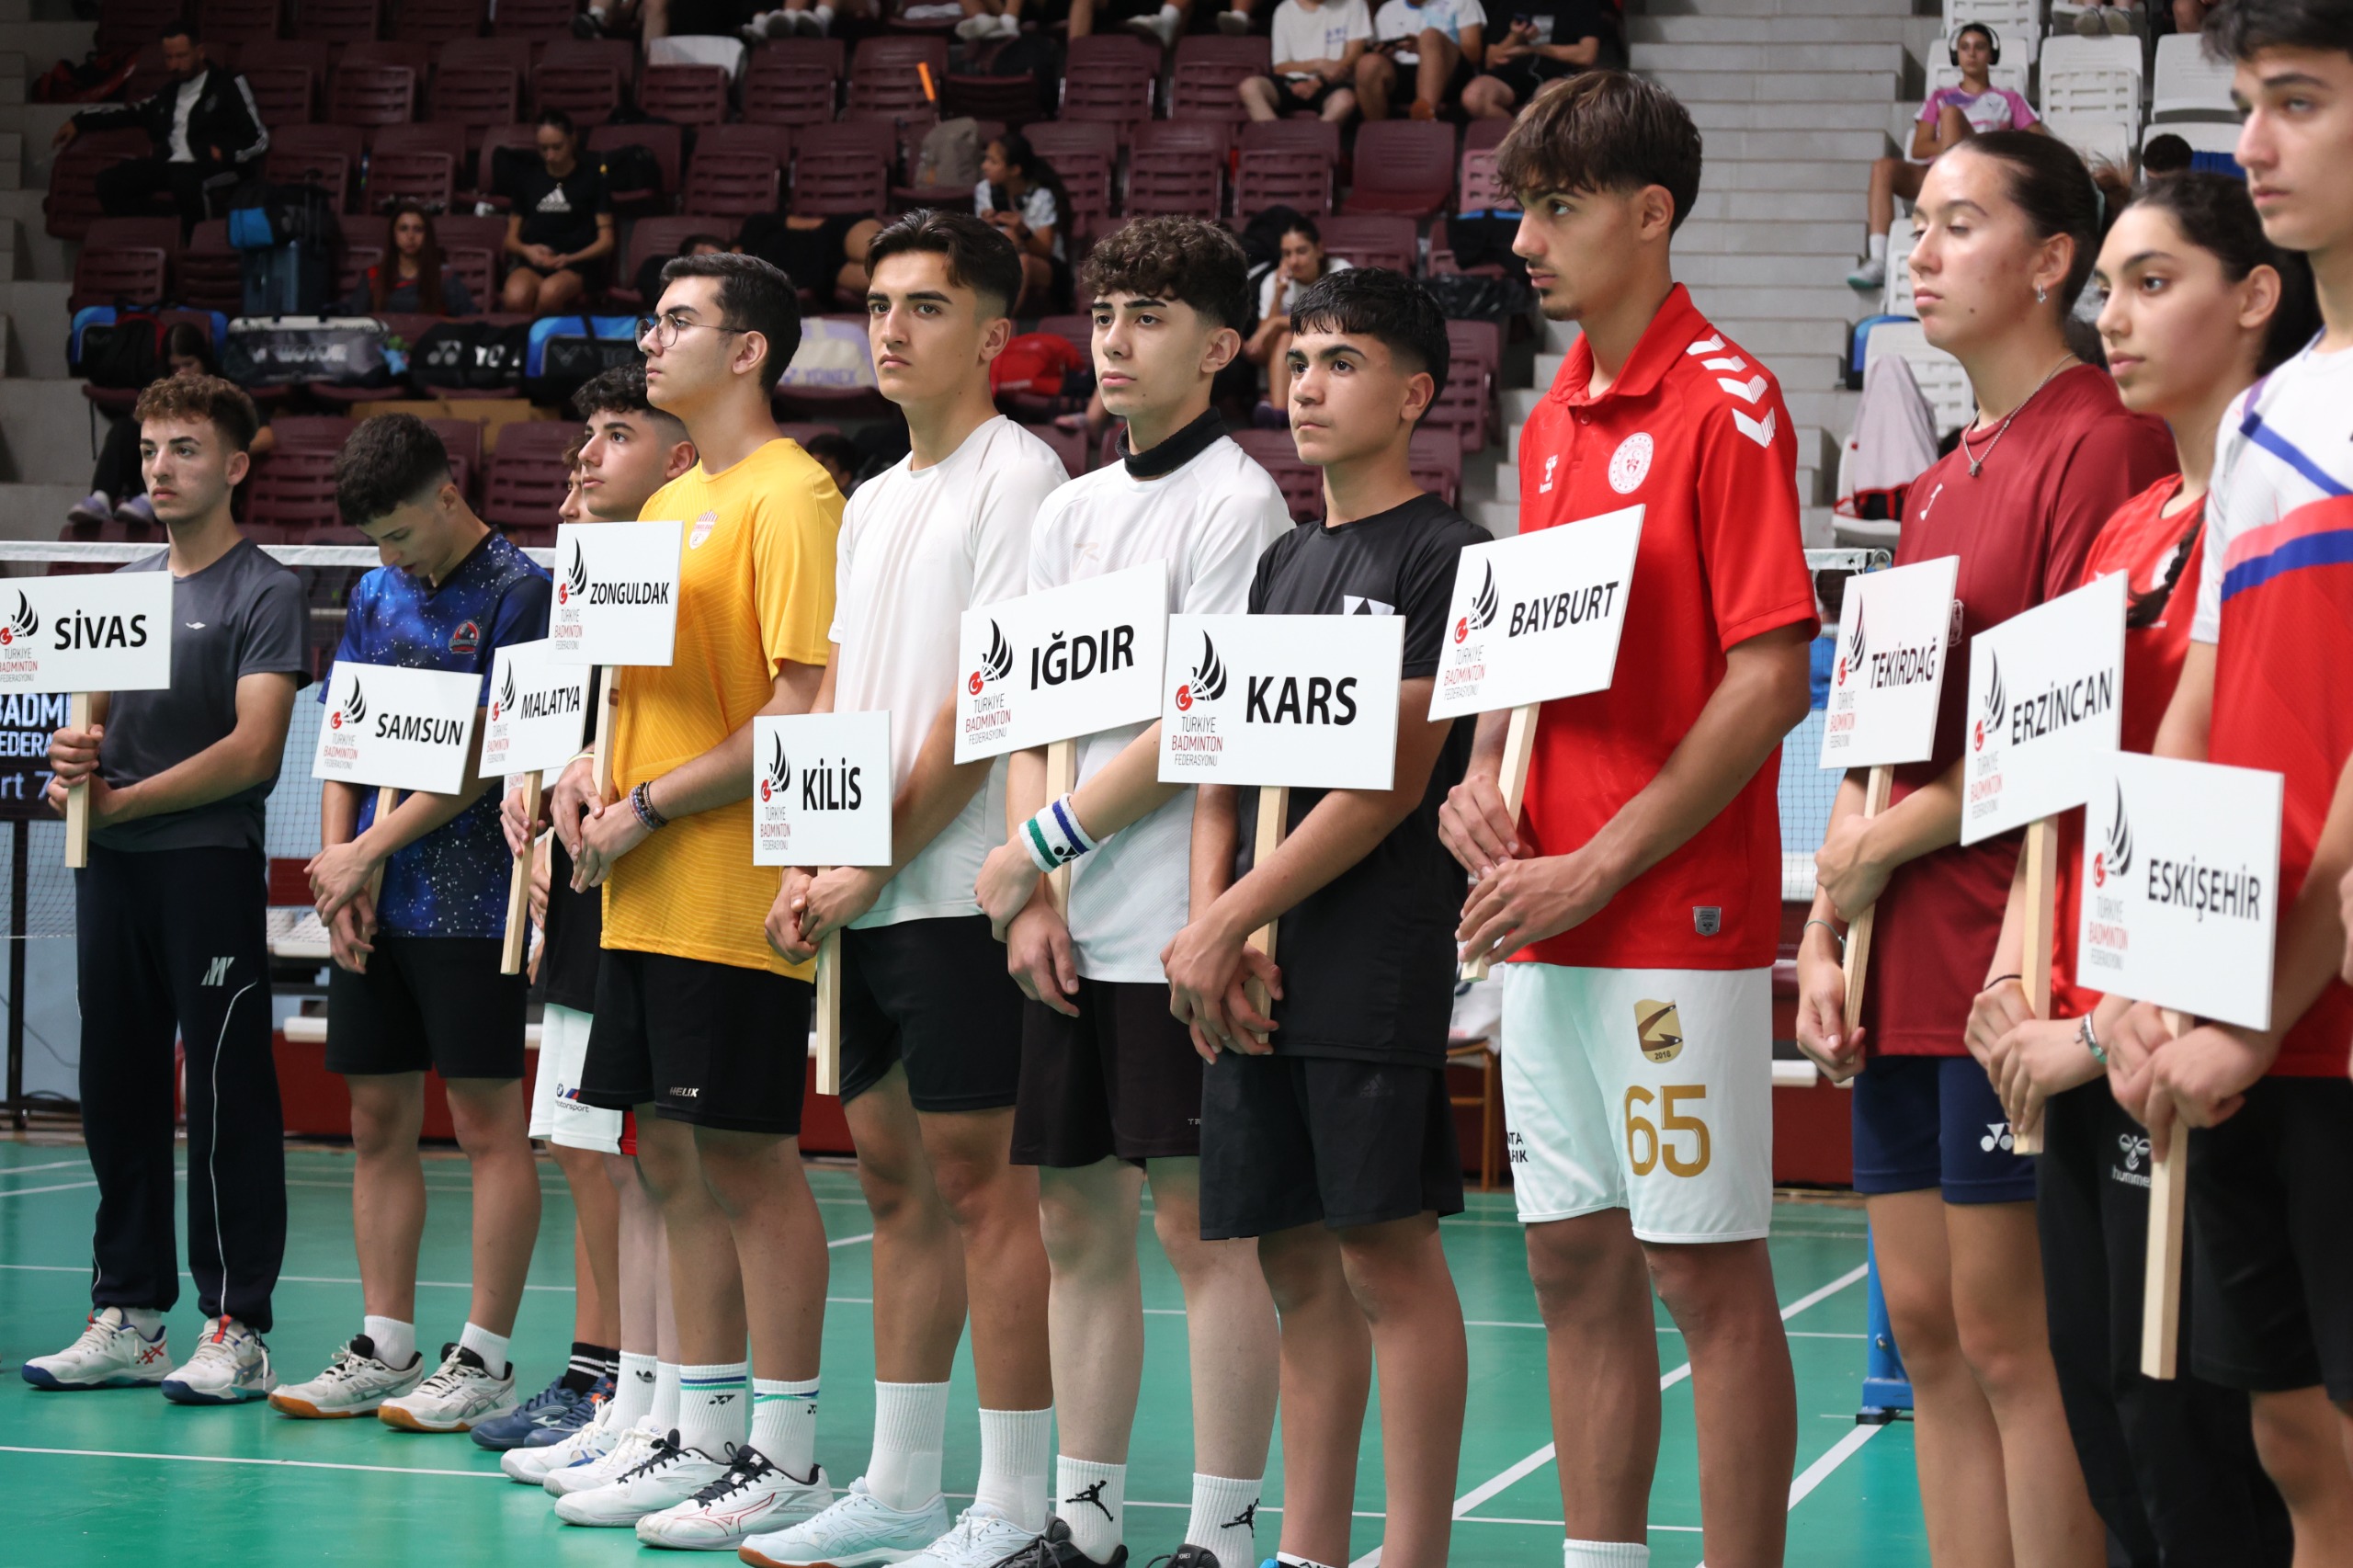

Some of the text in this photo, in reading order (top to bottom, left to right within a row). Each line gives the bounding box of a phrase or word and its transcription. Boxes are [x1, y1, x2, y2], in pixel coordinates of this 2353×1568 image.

[589, 582, 669, 605] ZONGULDAK
[1508, 581, 1619, 638] BAYBURT
[54, 609, 147, 650] SİVAS
[1030, 624, 1134, 691] IĞDIR
[1870, 635, 1938, 689] TEKİRDAĞ
[0, 693, 71, 727] ADMI
[520, 686, 580, 720] MALATYA
[974, 693, 1005, 714] TÜRKİYE
[1245, 676, 1358, 726] KARS
[2012, 667, 2113, 746] ERZİNCAN
[375, 713, 463, 745] SAMSUN
[969, 728, 1006, 745] FEDERASYONU
[1181, 714, 1216, 733] TÜRKİYE
[1175, 754, 1218, 767] FEDERASYONU
[34, 770, 53, 800] 7
[802, 757, 862, 810] KİLİS
[2148, 854, 2261, 923] ESKİŞEHİR
[670, 1086, 699, 1097] HELIX
[1624, 1085, 1711, 1177] 65
[2112, 1165, 2151, 1187] humme
